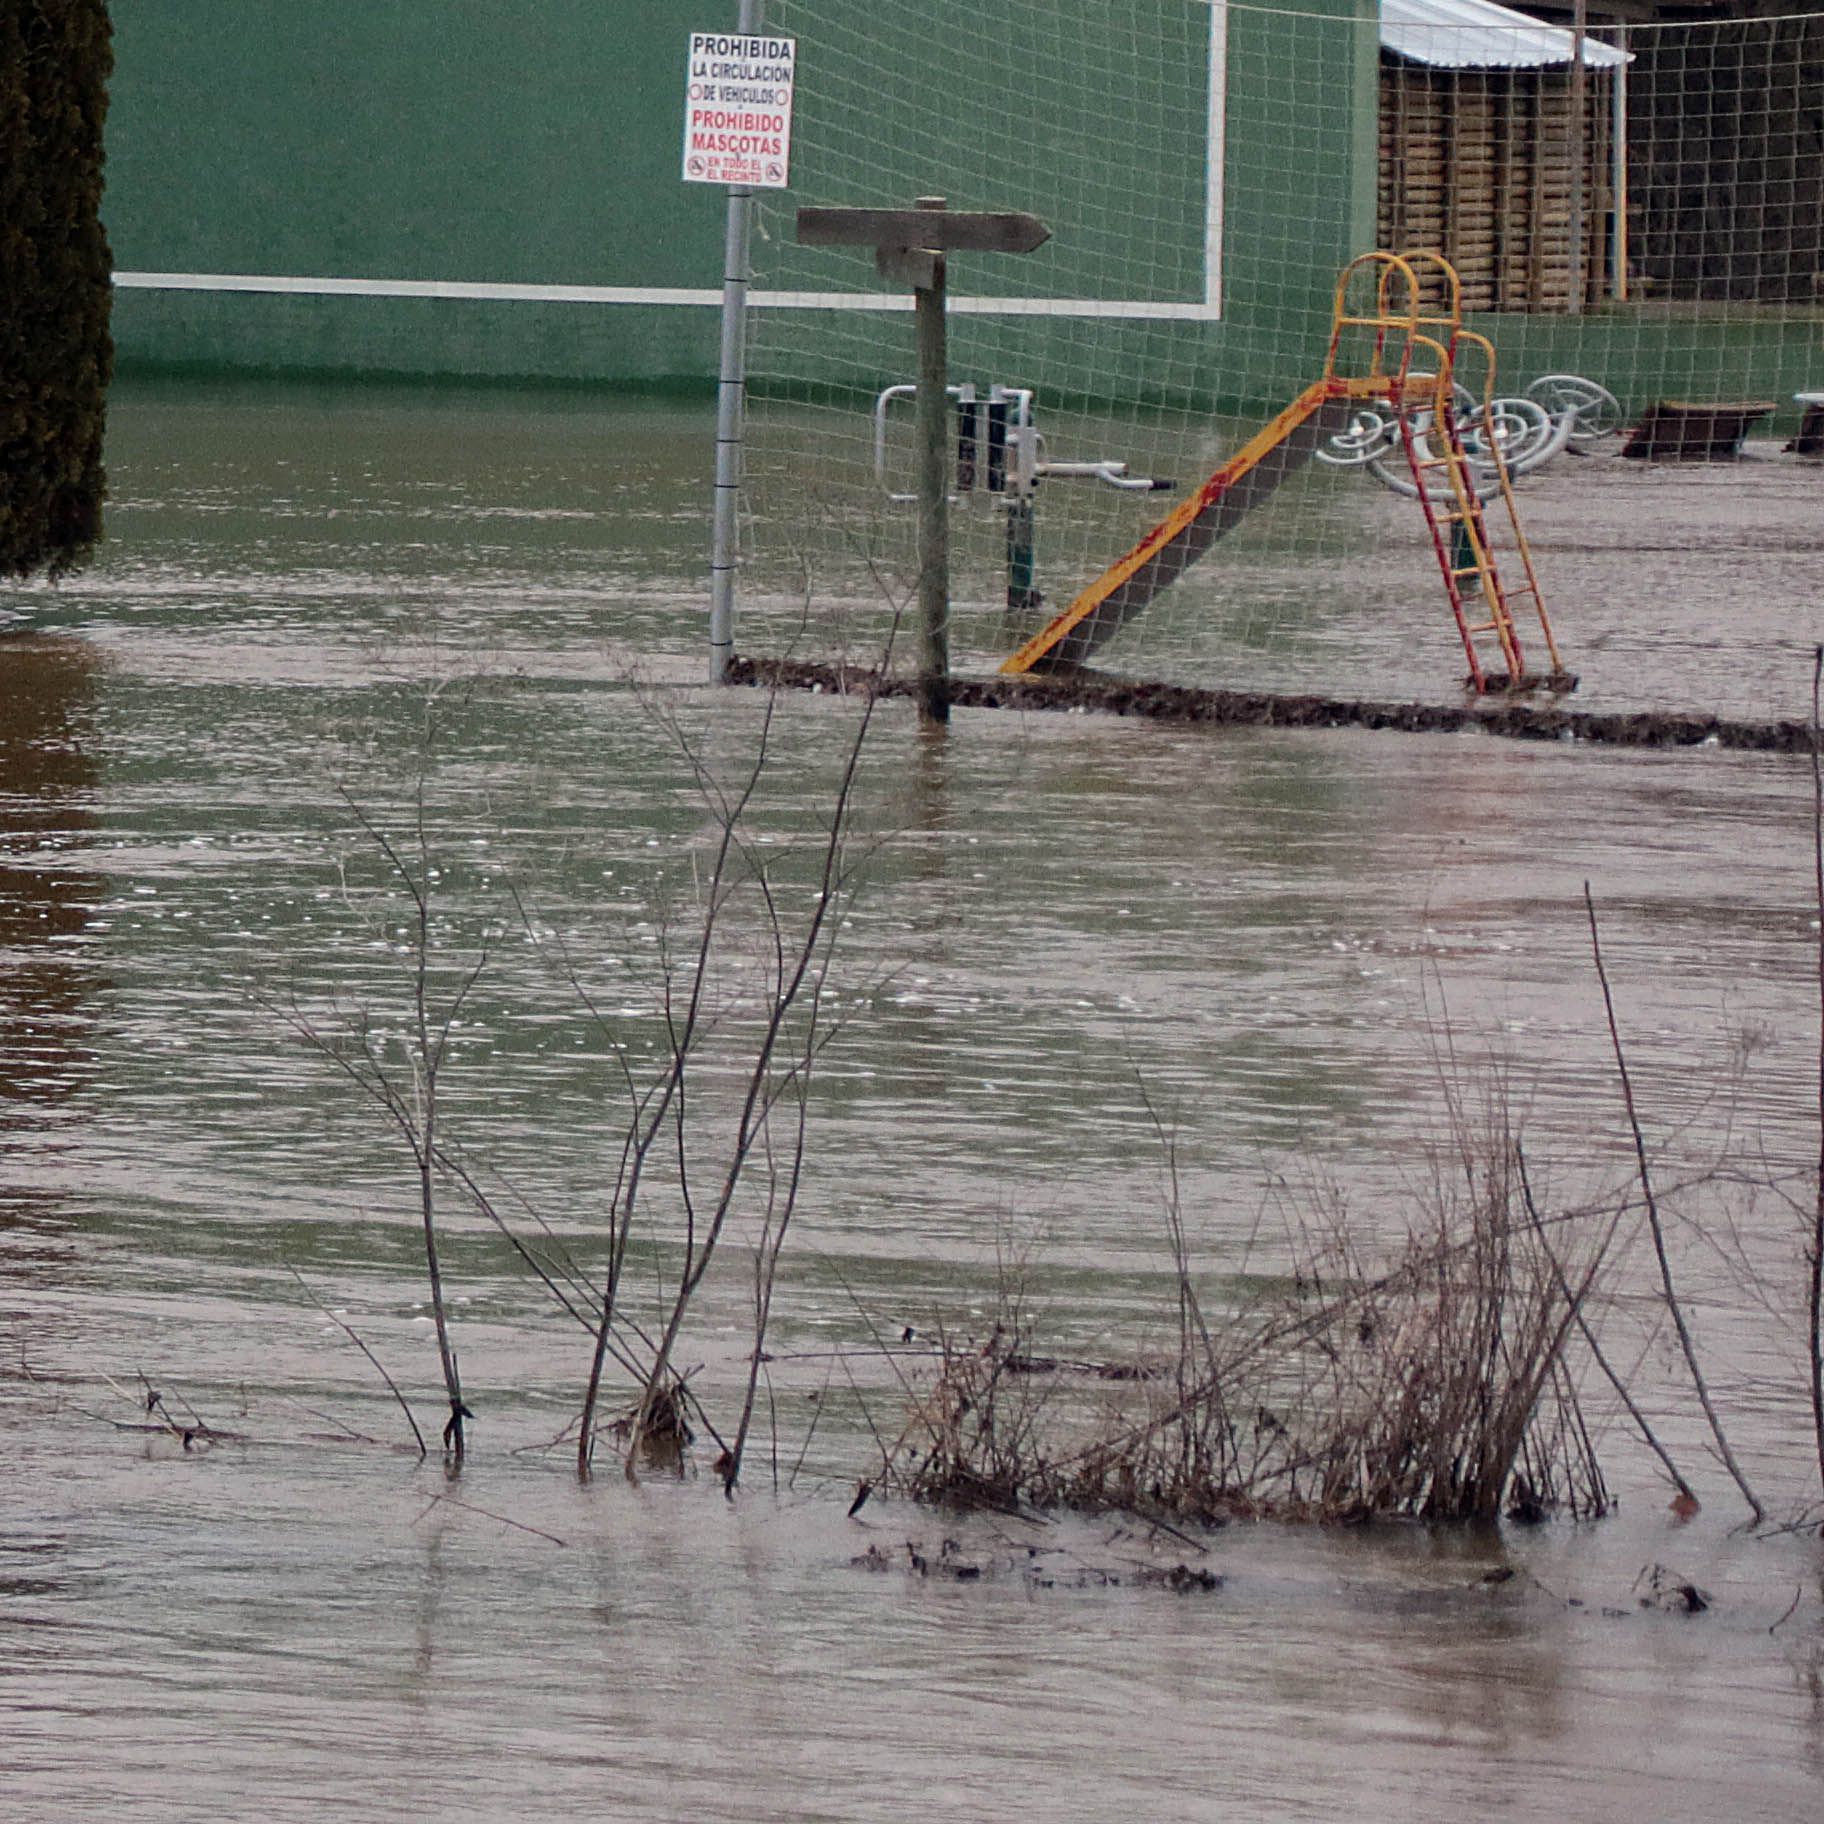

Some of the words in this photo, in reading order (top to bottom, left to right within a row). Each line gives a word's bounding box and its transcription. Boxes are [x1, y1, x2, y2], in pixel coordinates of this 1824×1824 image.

[693, 36, 791, 60] PROHIBIDA
[693, 61, 706, 77] LA
[703, 84, 716, 101] DE
[692, 109, 784, 133] PROHIBIDO
[692, 132, 781, 156] MASCOTAS
